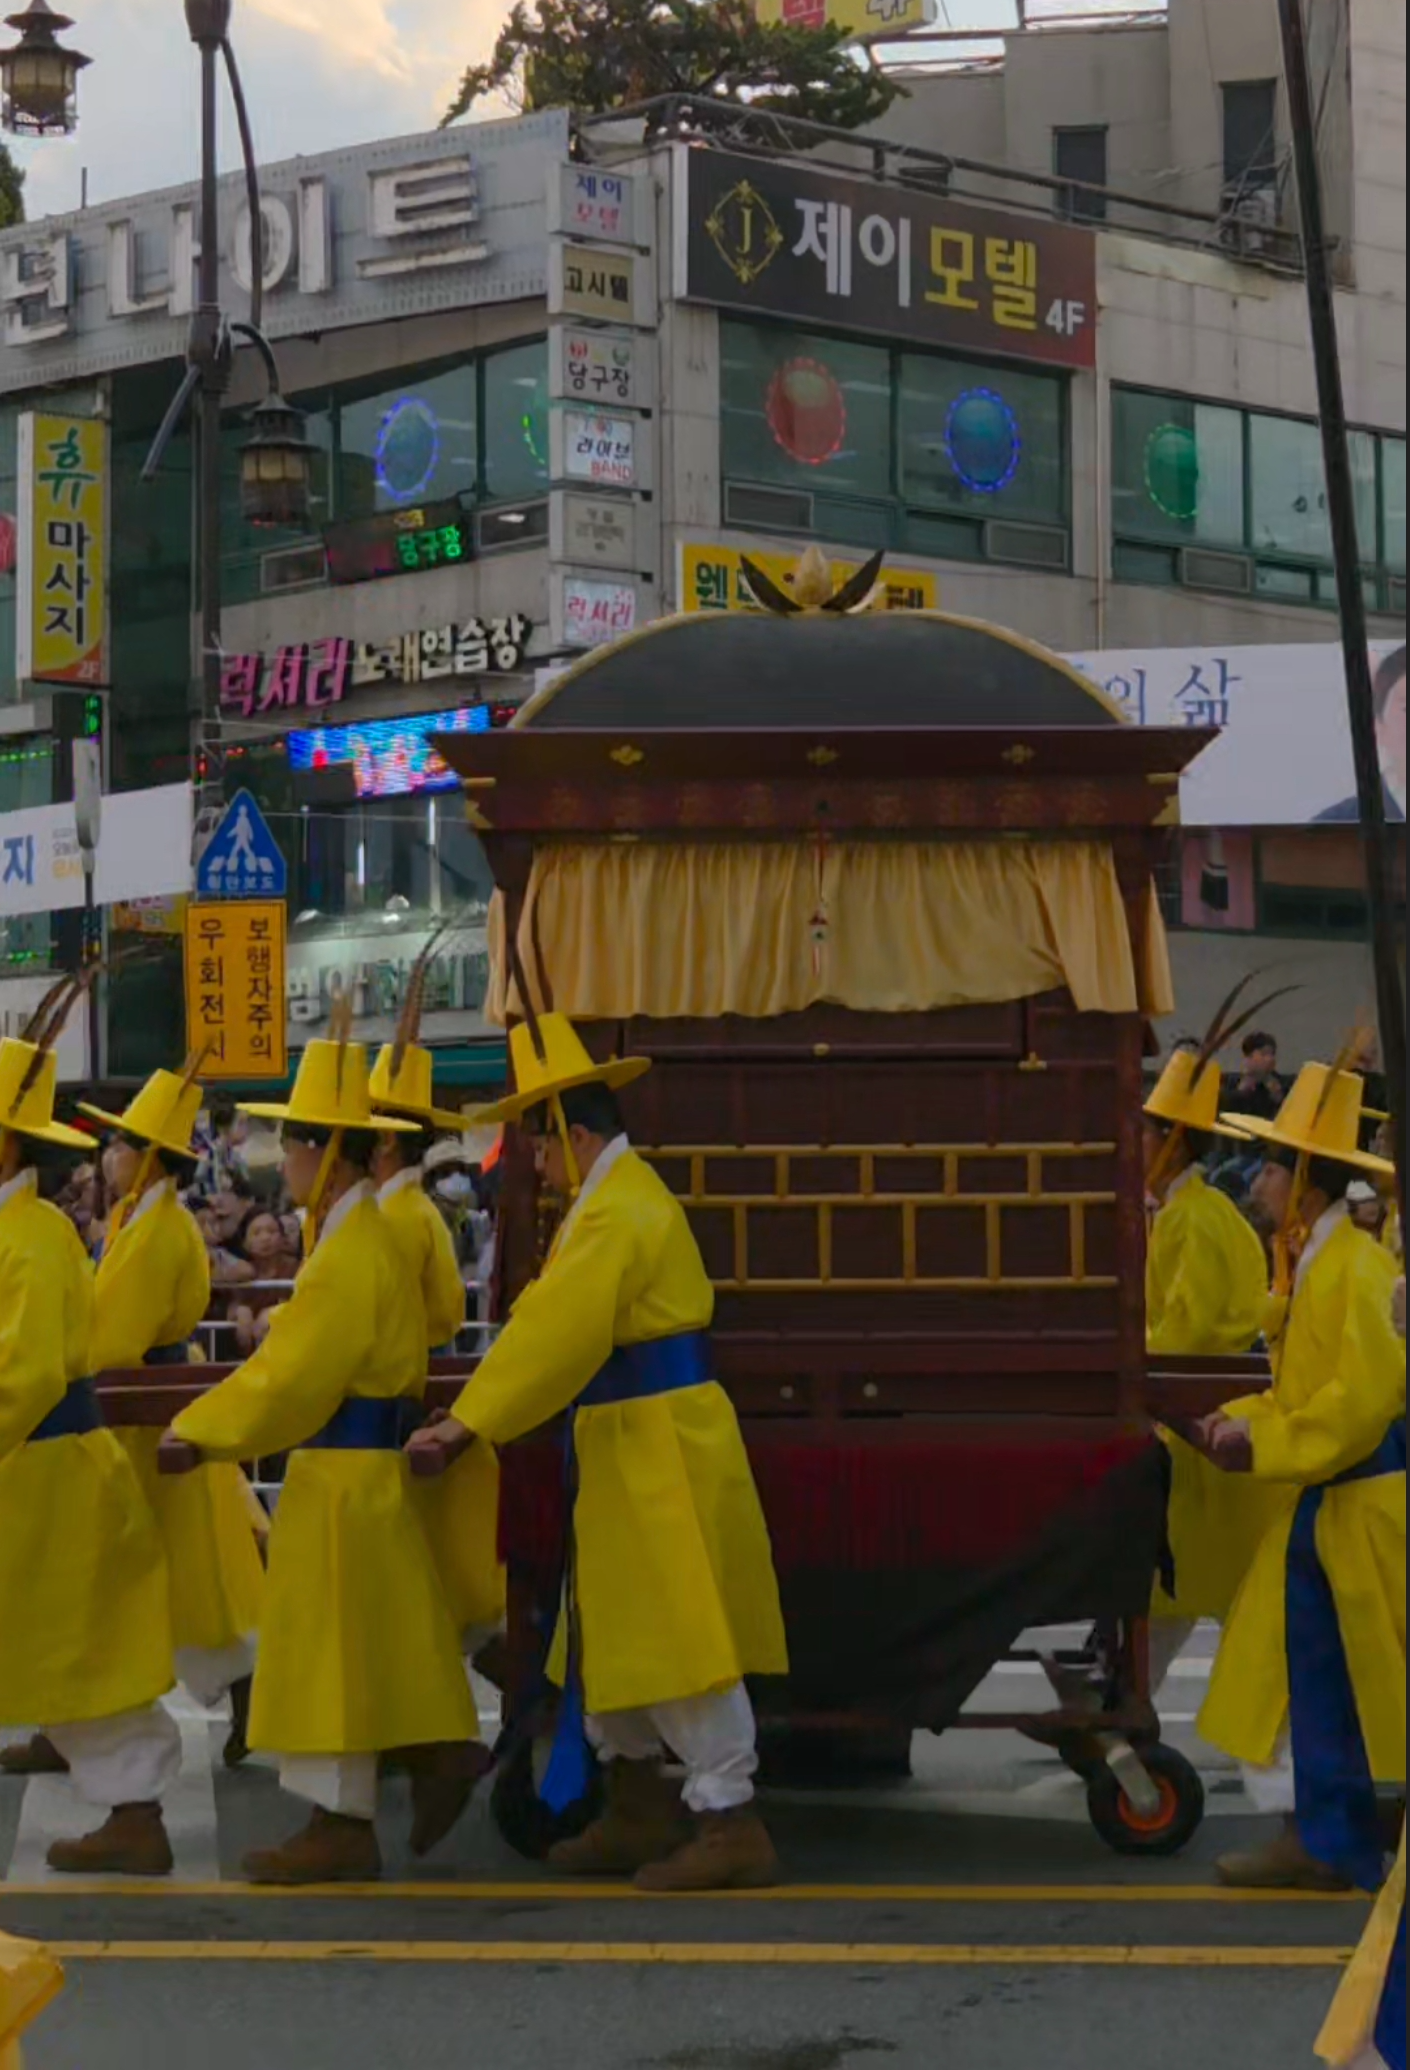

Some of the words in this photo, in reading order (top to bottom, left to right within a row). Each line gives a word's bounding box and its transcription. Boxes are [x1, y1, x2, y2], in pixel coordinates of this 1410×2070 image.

[575, 173, 621, 203] 제이
[791, 198, 911, 308] 제이
[924, 225, 1037, 331] 모텔
[1045, 298, 1085, 336] 4F
[568, 362, 630, 398] 당구장
[590, 459, 631, 482] BAND
[45, 520, 91, 646] 마사지
[78, 659, 98, 679] 2F
[353, 613, 527, 684] 노래연습장
[247, 917, 273, 1060] 보행자주의
